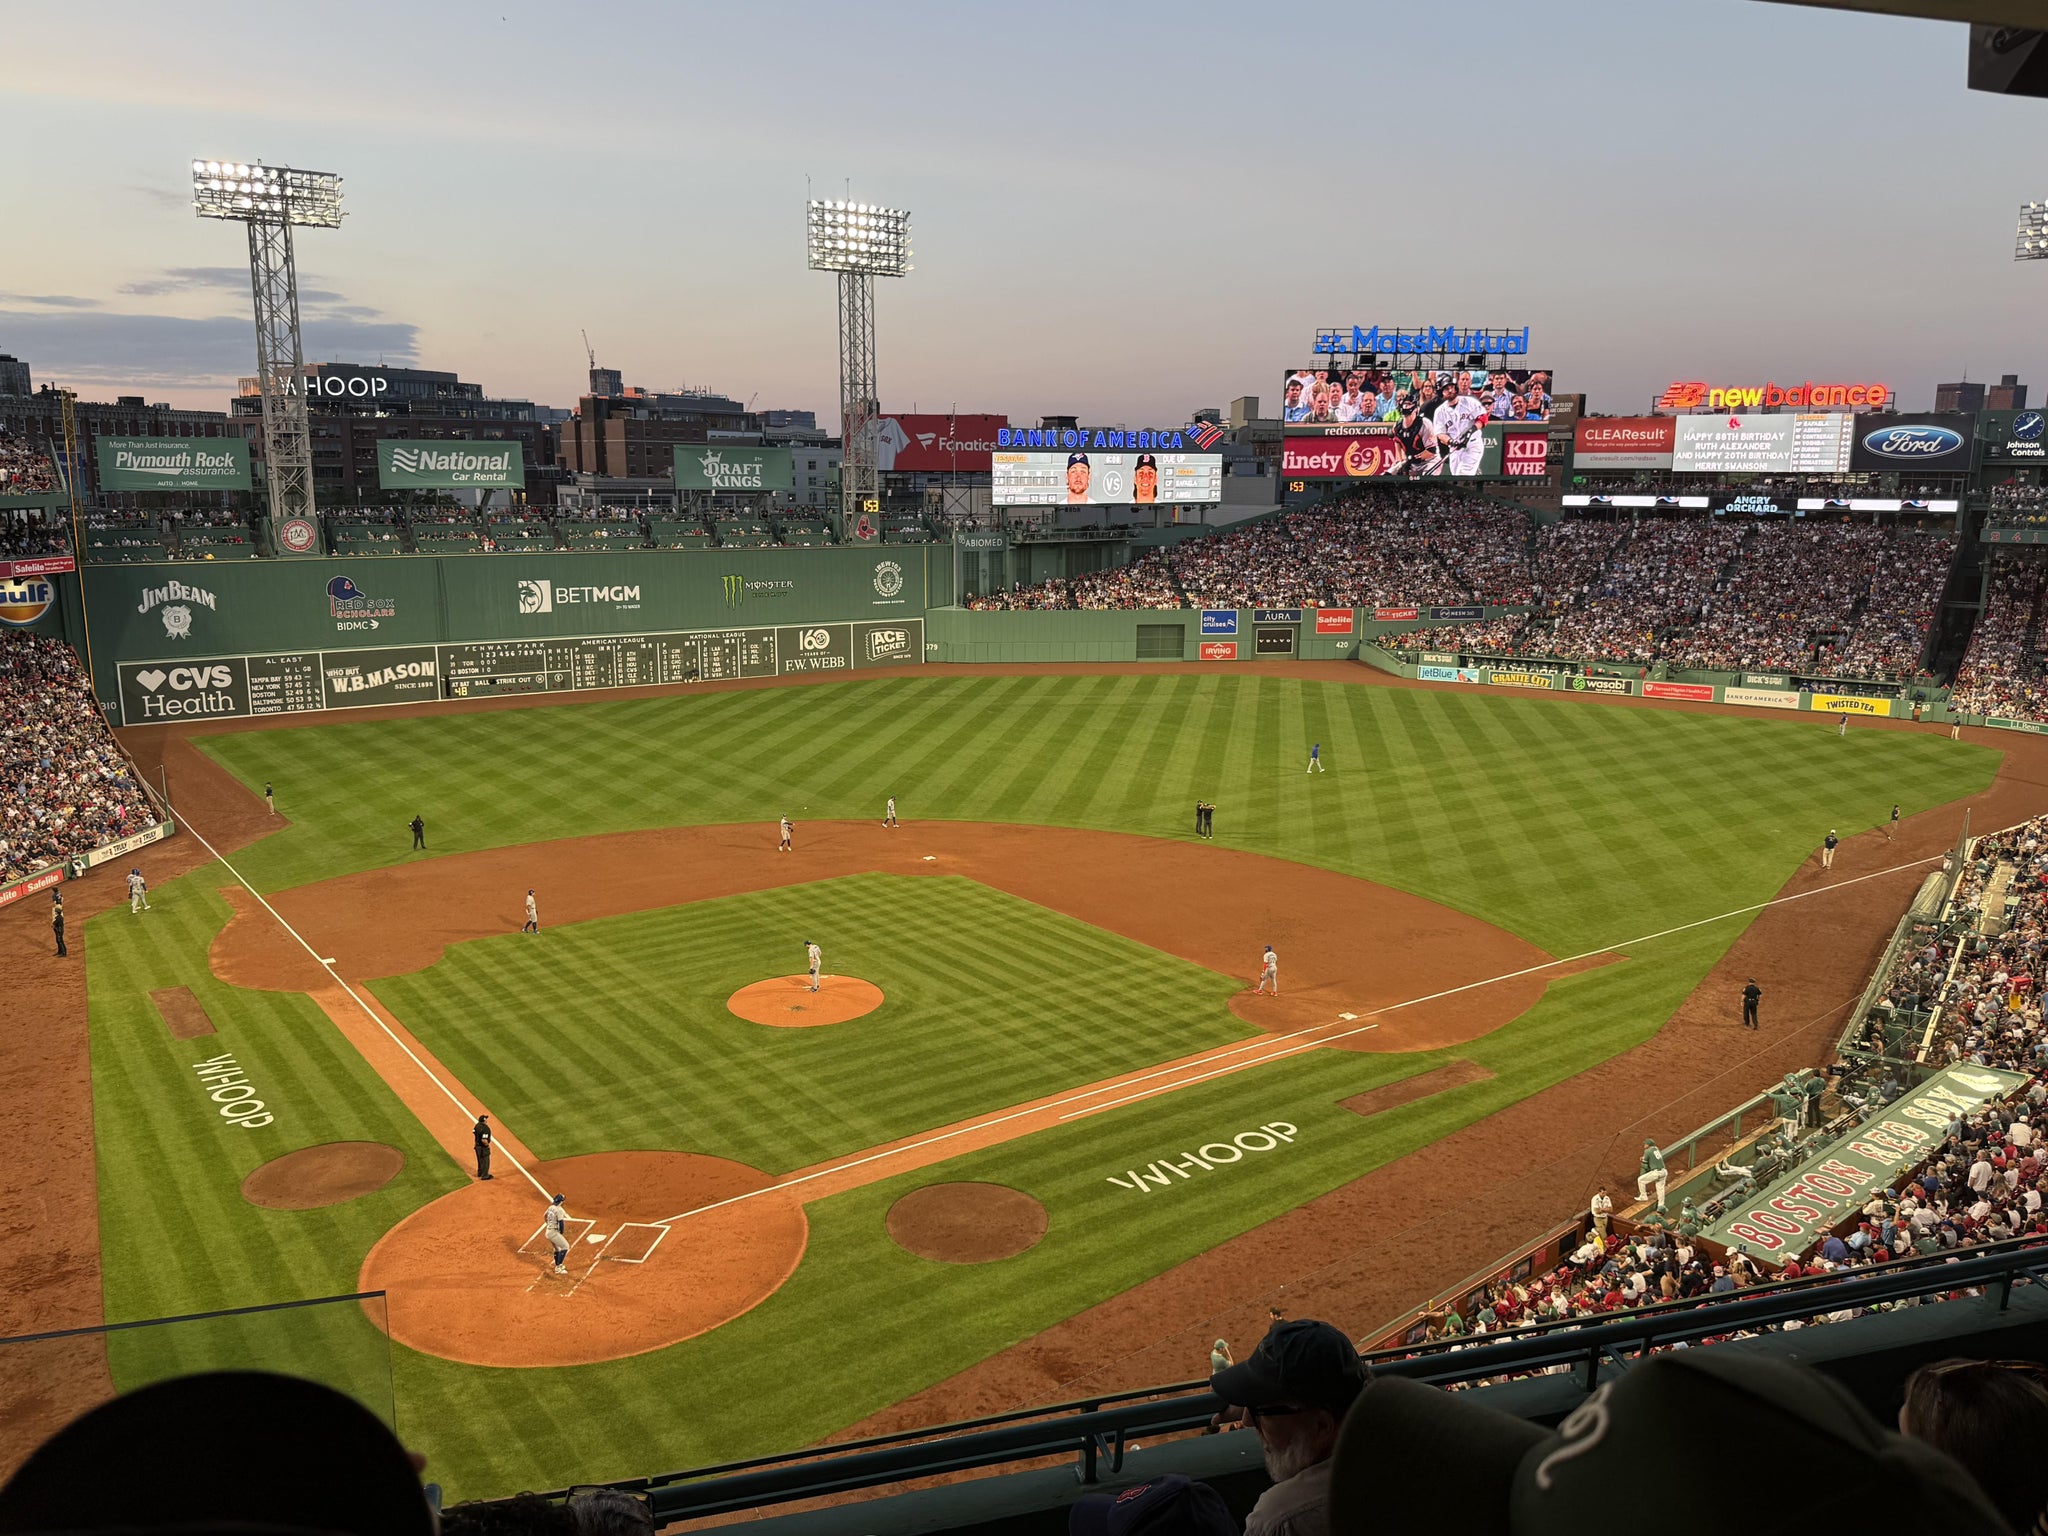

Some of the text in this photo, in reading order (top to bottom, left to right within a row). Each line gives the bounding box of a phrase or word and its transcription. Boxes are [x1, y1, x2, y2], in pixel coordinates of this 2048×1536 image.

[1352, 325, 1528, 353] MassMutual
[279, 376, 387, 397] WHOOP
[1709, 382, 1888, 407] new balance
[1325, 426, 1387, 435] redsox.com
[1585, 429, 1664, 440] CLEAResult
[1741, 432, 1785, 440] BIRTHDAY
[998, 429, 1182, 448] BANK OF AMERICA
[1882, 430, 1943, 452] Ford
[2006, 441, 2040, 449] Johnson
[2012, 448, 2045, 456] Controls
[116, 452, 234, 469] Plymouth Rock
[420, 451, 510, 470] National
[474, 472, 506, 480] Rental
[703, 463, 762, 477] DRAFT
[712, 475, 762, 487] KINGS
[1106, 478, 1120, 490] VS
[1734, 496, 1771, 504] ANGRY
[1726, 504, 1778, 512] ORCHARD
[965, 538, 1002, 547] ABIOMED
[2012, 531, 2039, 544] 4 1
[138, 580, 216, 614] JIM BEAM
[556, 586, 640, 604] BETMGM
[336, 599, 395, 610] RED SOX
[336, 609, 395, 618] SCHOLARS
[337, 621, 368, 630] BIDMC
[799, 629, 830, 650] 160
[874, 631, 905, 645] ACE
[875, 642, 905, 654] TICKET
[809, 656, 845, 669] WEBB
[168, 665, 232, 691] CVS
[326, 669, 343, 677] WHO
[332, 661, 435, 693] W.B.MASON
[1422, 668, 1452, 678] jetBlue
[1491, 674, 1529, 683] GRANITE
[1531, 674, 1552, 687] CITY
[1587, 680, 1625, 690] wasabi
[1747, 676, 1769, 684] DICK'S
[454, 687, 468, 696] 48
[142, 691, 235, 717] Health
[1826, 701, 1875, 712] TWISTED TEA
[27, 874, 59, 892] Safelite
[192, 1053, 274, 1128] WHOOP
[1106, 1121, 1298, 1192] WHOOP
[1727, 1085, 1984, 1250] BOSTON RED SOX
